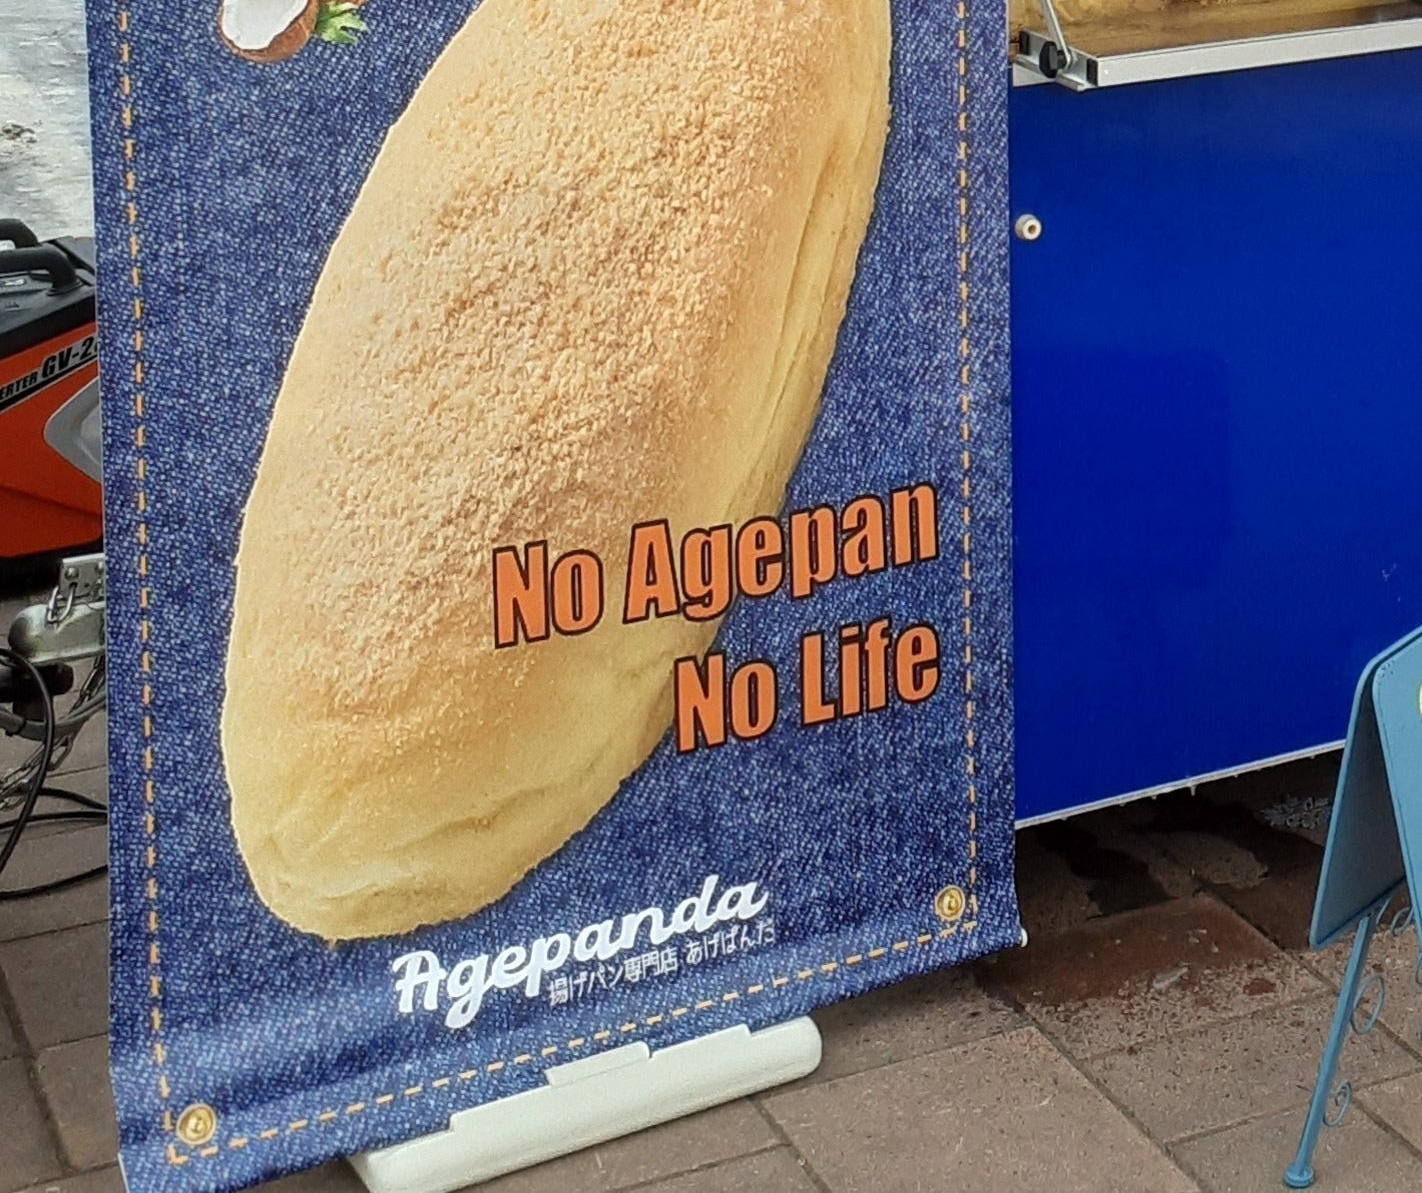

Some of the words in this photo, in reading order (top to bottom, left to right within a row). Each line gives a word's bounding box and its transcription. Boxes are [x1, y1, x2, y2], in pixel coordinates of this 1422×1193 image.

[42, 336, 98, 378] GV-2
[492, 539, 604, 650] No
[622, 480, 940, 625] Agepan
[672, 652, 779, 755] No
[800, 615, 942, 727] Life
[391, 875, 770, 1030] Agepanda
